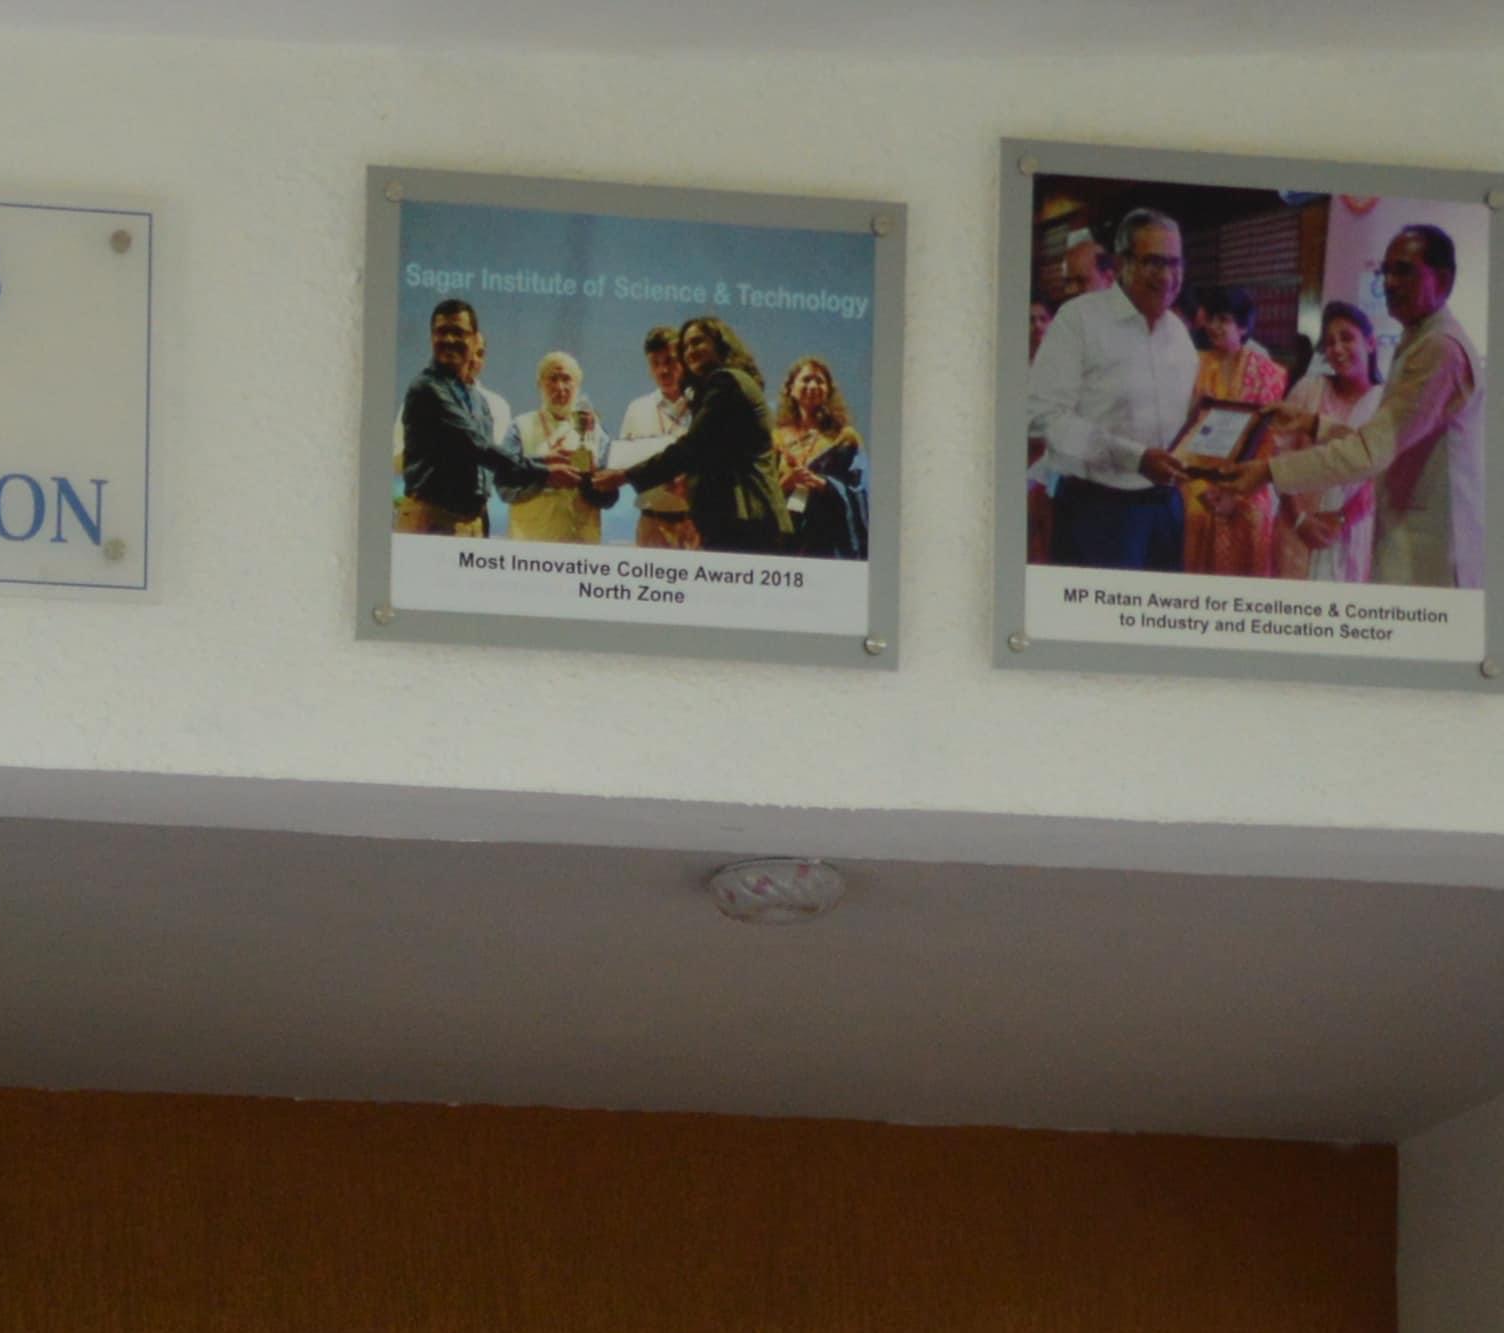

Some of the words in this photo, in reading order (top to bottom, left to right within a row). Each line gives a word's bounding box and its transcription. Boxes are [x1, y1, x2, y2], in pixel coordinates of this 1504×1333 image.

[405, 262, 475, 292] Sagar
[481, 268, 578, 296] Institute
[583, 274, 607, 297] of
[613, 277, 707, 304] Science
[713, 282, 731, 304] &
[736, 283, 870, 318] Technology
[458, 552, 505, 571] Most
[511, 555, 611, 577] Innovative
[617, 561, 689, 584] College
[694, 566, 754, 586] Award
[760, 570, 804, 588] 2018
[578, 582, 631, 601] North
[637, 585, 685, 604] Zone
[1063, 587, 1090, 605] MP
[1094, 589, 1143, 607] Ratan
[1147, 592, 1200, 610] Award
[1204, 596, 1229, 612] for
[1233, 597, 1323, 618] Excellence
[1327, 602, 1341, 618] &
[1344, 602, 1448, 624] Contribution
[1119, 613, 1136, 629] to
[1140, 613, 1210, 635] Industry
[1214, 617, 1247, 634] and
[1251, 618, 1334, 639] Education
[1339, 623, 1393, 642] Sector
